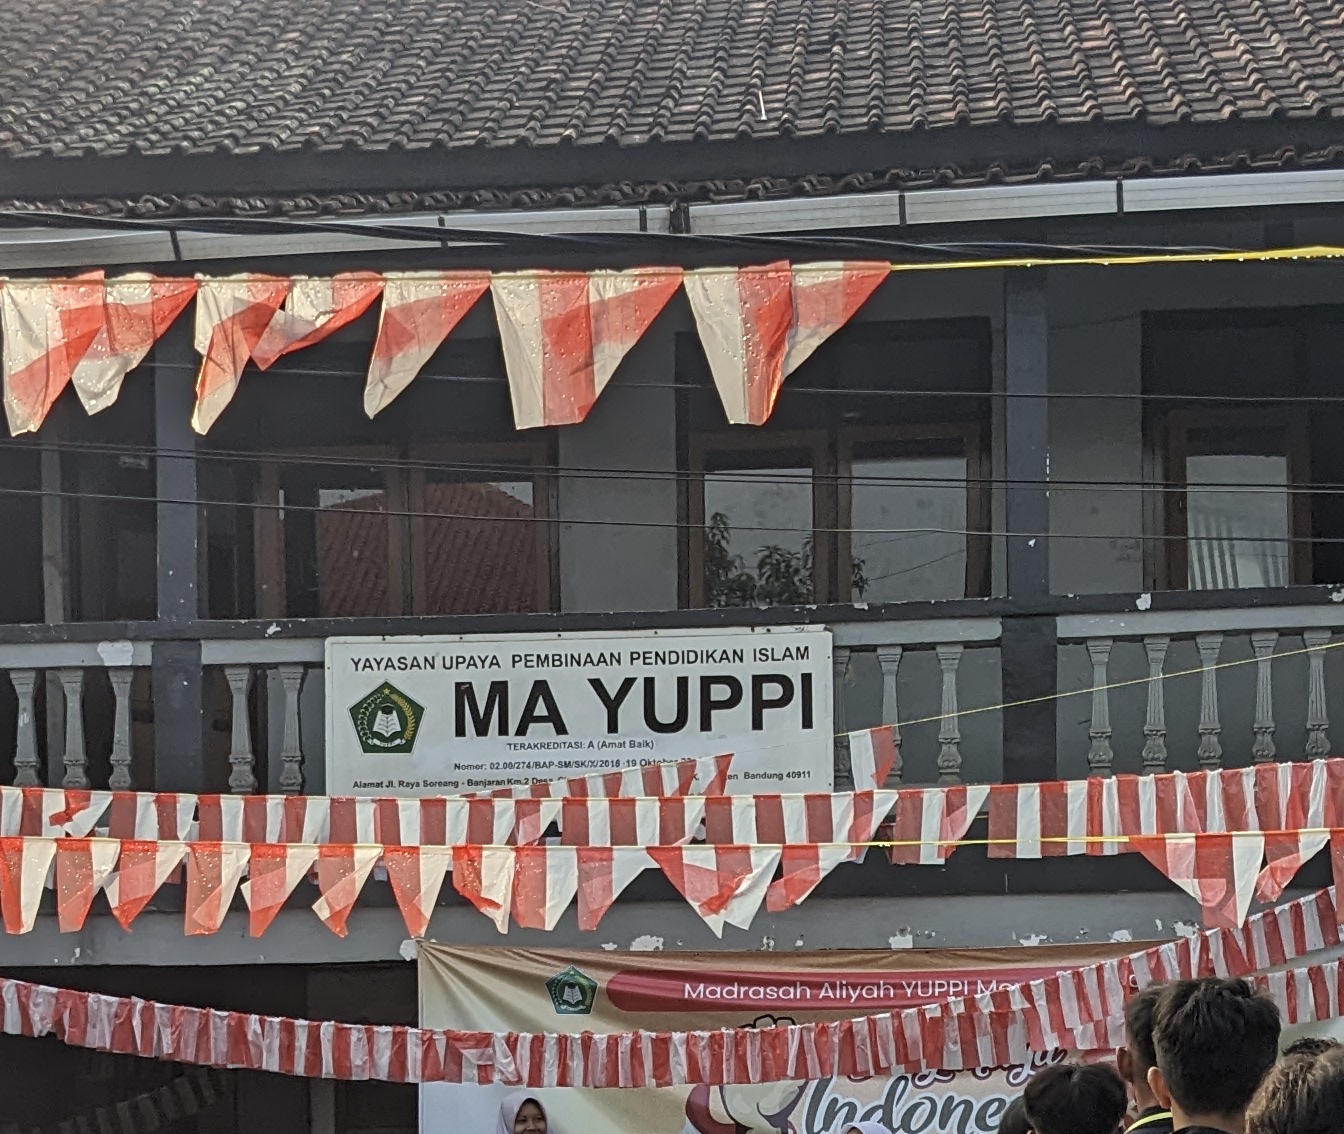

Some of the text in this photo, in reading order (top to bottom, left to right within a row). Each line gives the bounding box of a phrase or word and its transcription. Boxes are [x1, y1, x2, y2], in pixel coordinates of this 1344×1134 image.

[350, 645, 810, 672] YAYASAN UPAYA PEMBINAAN PENDIDIKAN ISLAM
[454, 672, 814, 738] MA YUPPI
[506, 739, 654, 751] TERAKREDITASI: A (Amat Baik)
[352, 780, 384, 789] Alamat
[398, 779, 420, 790] Raya
[422, 778, 459, 790] Soreang
[467, 777, 505, 789] Banjaran
[743, 771, 784, 782] Bandung
[785, 770, 811, 779] 40911
[684, 980, 811, 1000] Madrasah
[819, 978, 894, 1003] Aliyah
[902, 979, 968, 998] YUPPI
